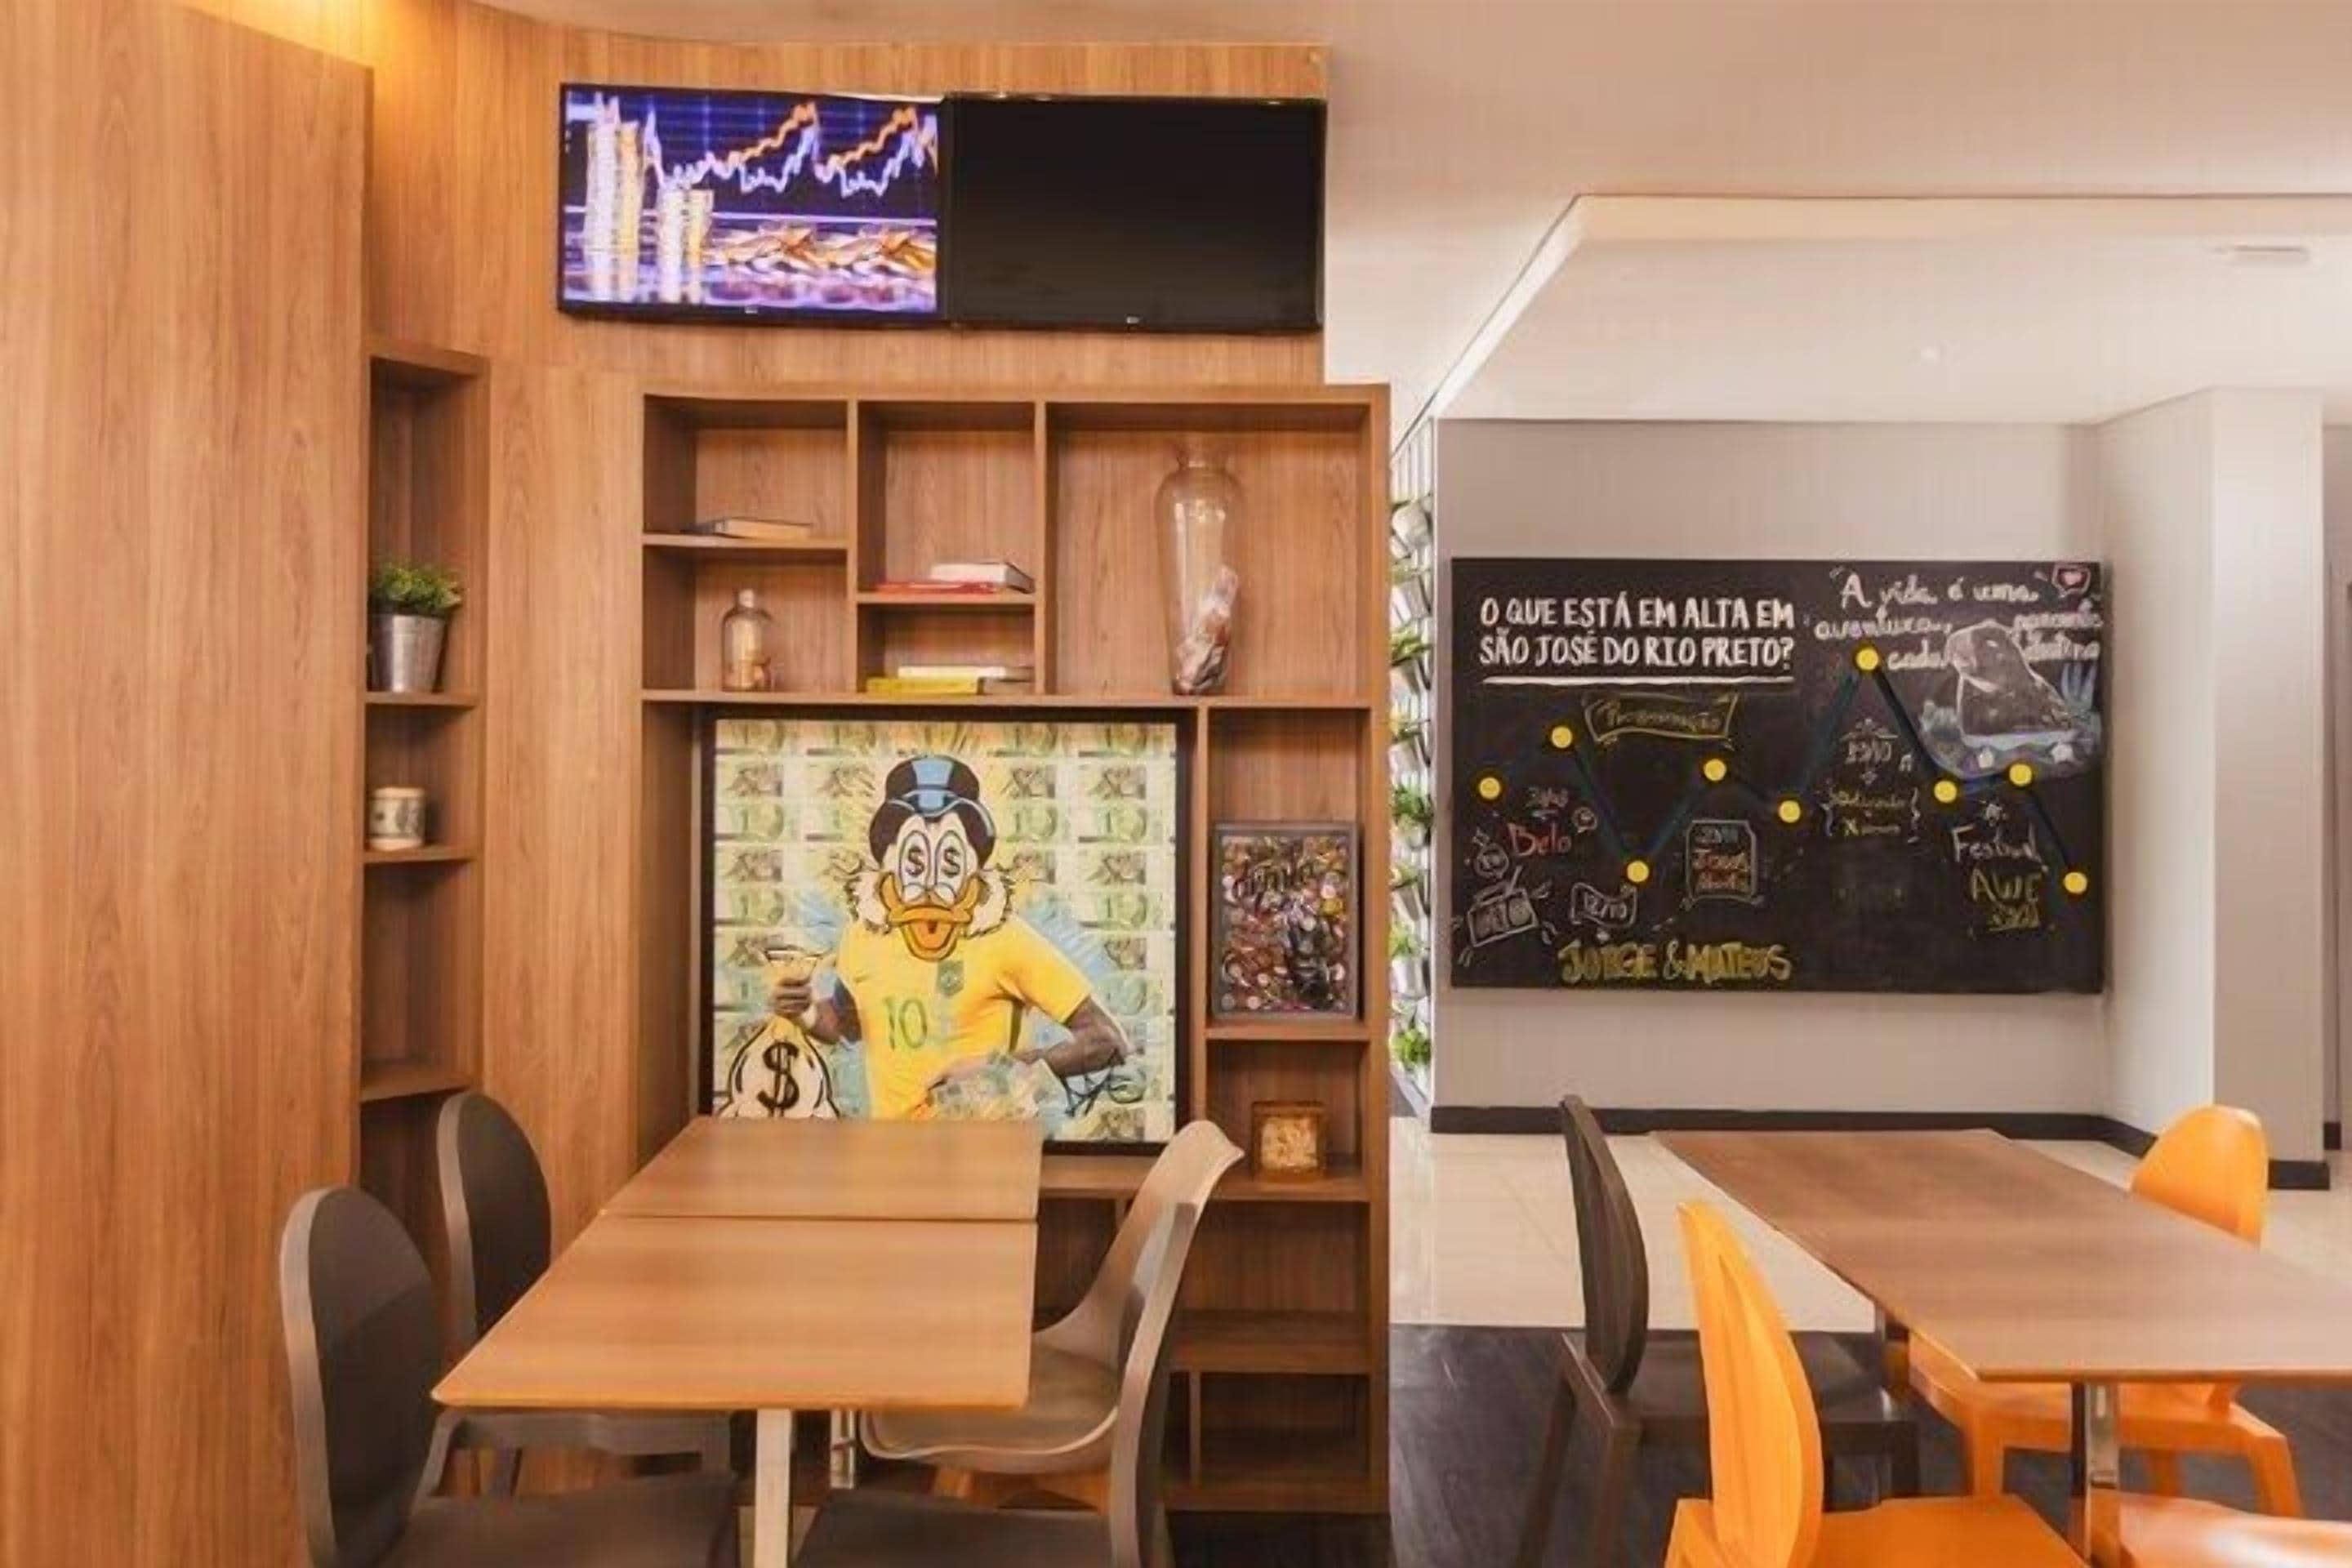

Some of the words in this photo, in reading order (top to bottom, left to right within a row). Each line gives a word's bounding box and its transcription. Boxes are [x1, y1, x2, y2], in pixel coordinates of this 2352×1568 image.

[1480, 597, 1500, 627] O
[1506, 597, 1557, 627] QUE
[1564, 590, 1632, 629] ESTÁ
[1638, 597, 1676, 629] EM
[1682, 597, 1750, 630] ALTA
[1756, 597, 1795, 630] EM
[1841, 572, 1873, 610] A
[1480, 626, 1530, 666] SÃO
[1535, 630, 1599, 667] JOSÉ
[1602, 636, 1641, 666] DO
[1645, 636, 1697, 667] RIO
[1701, 636, 1796, 671] PRETO?
[881, 996, 928, 1052] 10
